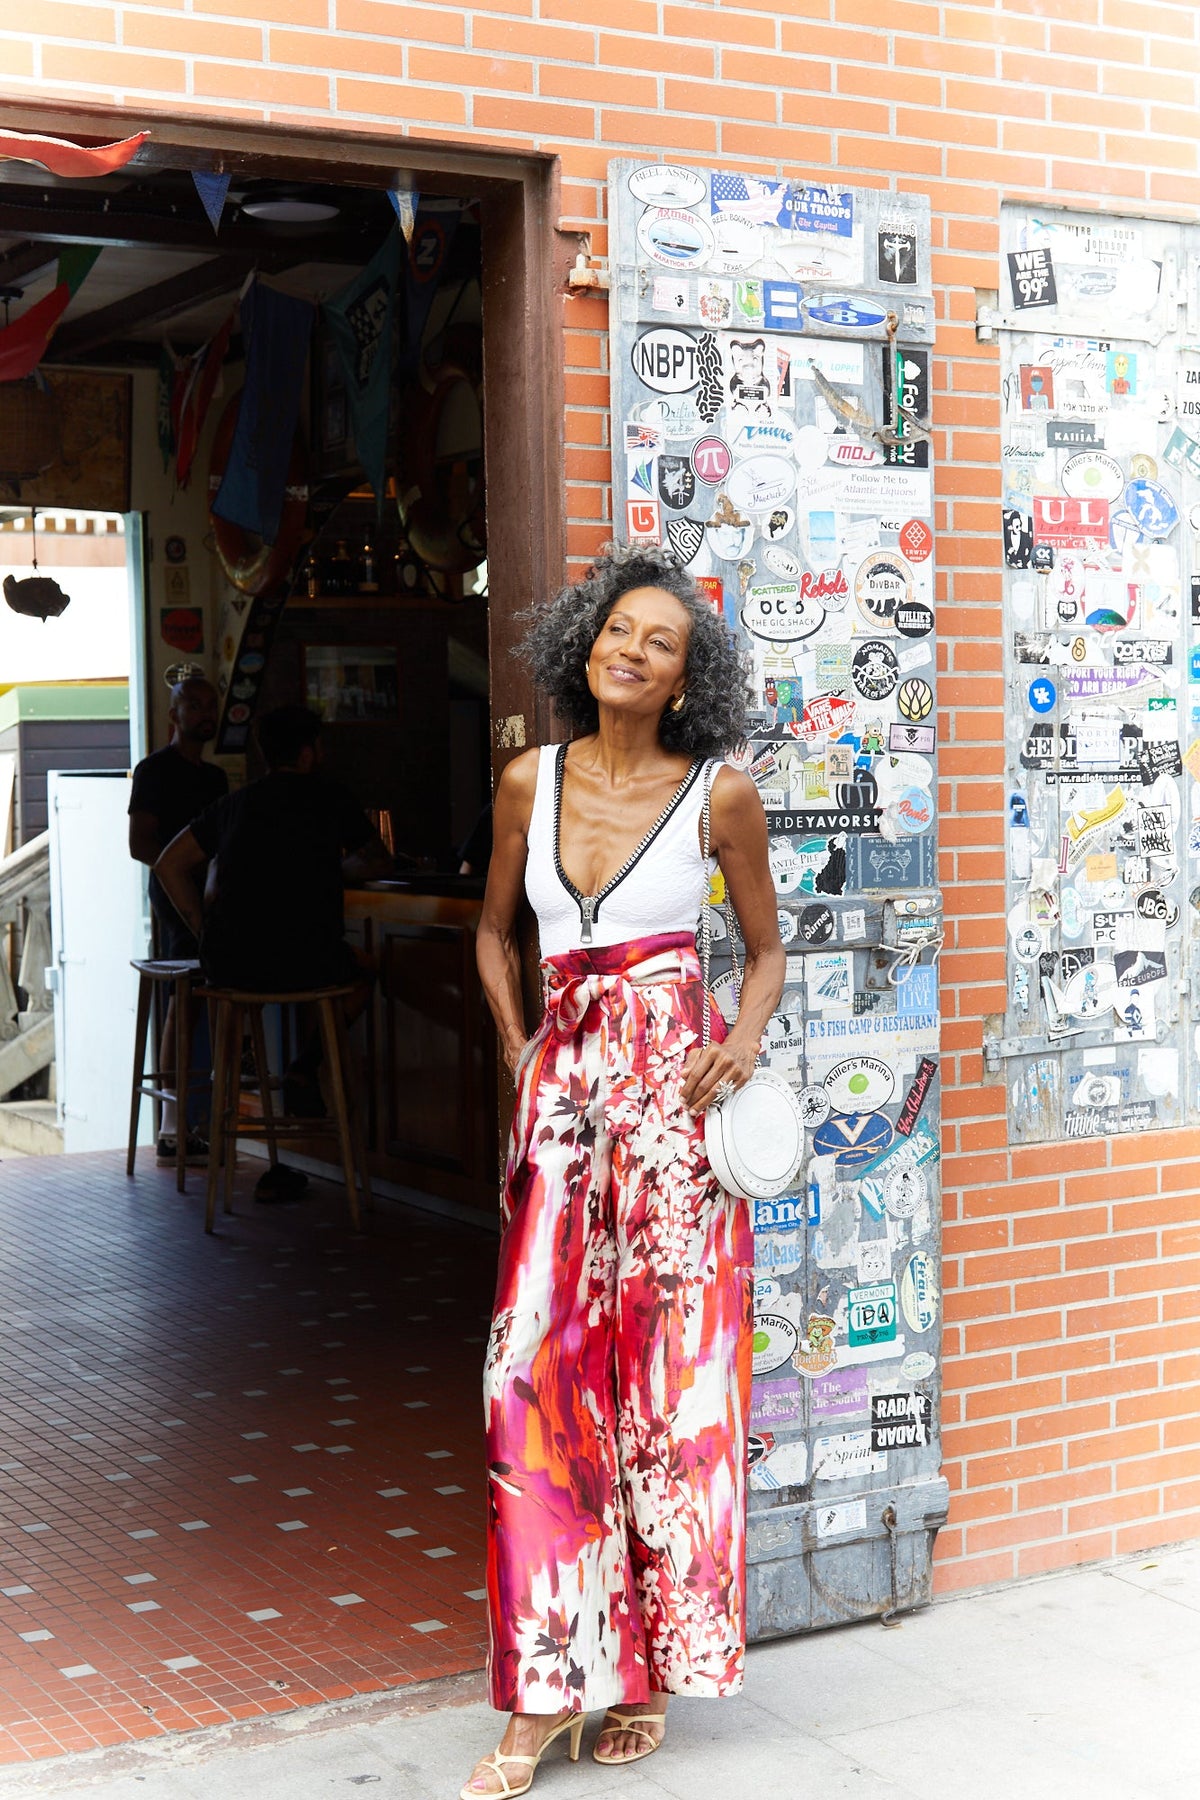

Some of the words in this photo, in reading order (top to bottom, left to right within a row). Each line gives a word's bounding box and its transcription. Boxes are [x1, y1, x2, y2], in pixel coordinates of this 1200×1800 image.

[786, 200, 808, 213] OUR
[811, 204, 851, 219] TROOPS
[798, 217, 812, 228] The
[1014, 251, 1046, 271] WE
[1016, 271, 1032, 280] ARE
[1033, 268, 1050, 279] THE
[1018, 278, 1049, 301] 99%
[641, 343, 696, 380] NBPT
[1186, 371, 1200, 384] ZA
[898, 384, 919, 464] Faiway
[1064, 454, 1093, 476] Miller's
[1094, 454, 1122, 480] Marina
[851, 474, 880, 484] Follow
[883, 474, 897, 484] Me
[843, 485, 879, 495] Atlantic
[880, 486, 917, 497] Liquors!
[880, 521, 900, 530] NCC
[751, 584, 797, 596] SCATTERED
[800, 570, 848, 600] Rebels
[751, 619, 767, 627] THE
[788, 618, 816, 626] SHACK
[898, 611, 931, 623] WILLIE'S
[1081, 681, 1100, 693] ARM
[806, 700, 832, 717] VANS
[813, 712, 830, 731] THE
[1137, 968, 1166, 982] EUROPE
[902, 993, 931, 1008] LIVE
[827, 1021, 846, 1037] FISH
[848, 1019, 871, 1035] CAMP
[874, 1018, 881, 1033] &
[883, 1013, 938, 1032] RESTAURANT
[770, 1038, 788, 1050] Salty
[826, 1061, 858, 1087] Miller's
[860, 1059, 891, 1082] Marina
[854, 1288, 890, 1300] VERMONT
[761, 1317, 793, 1337] Marina
[793, 1349, 838, 1367] TORTUGA
[820, 1382, 842, 1393] The
[876, 1396, 926, 1419] RADAR
